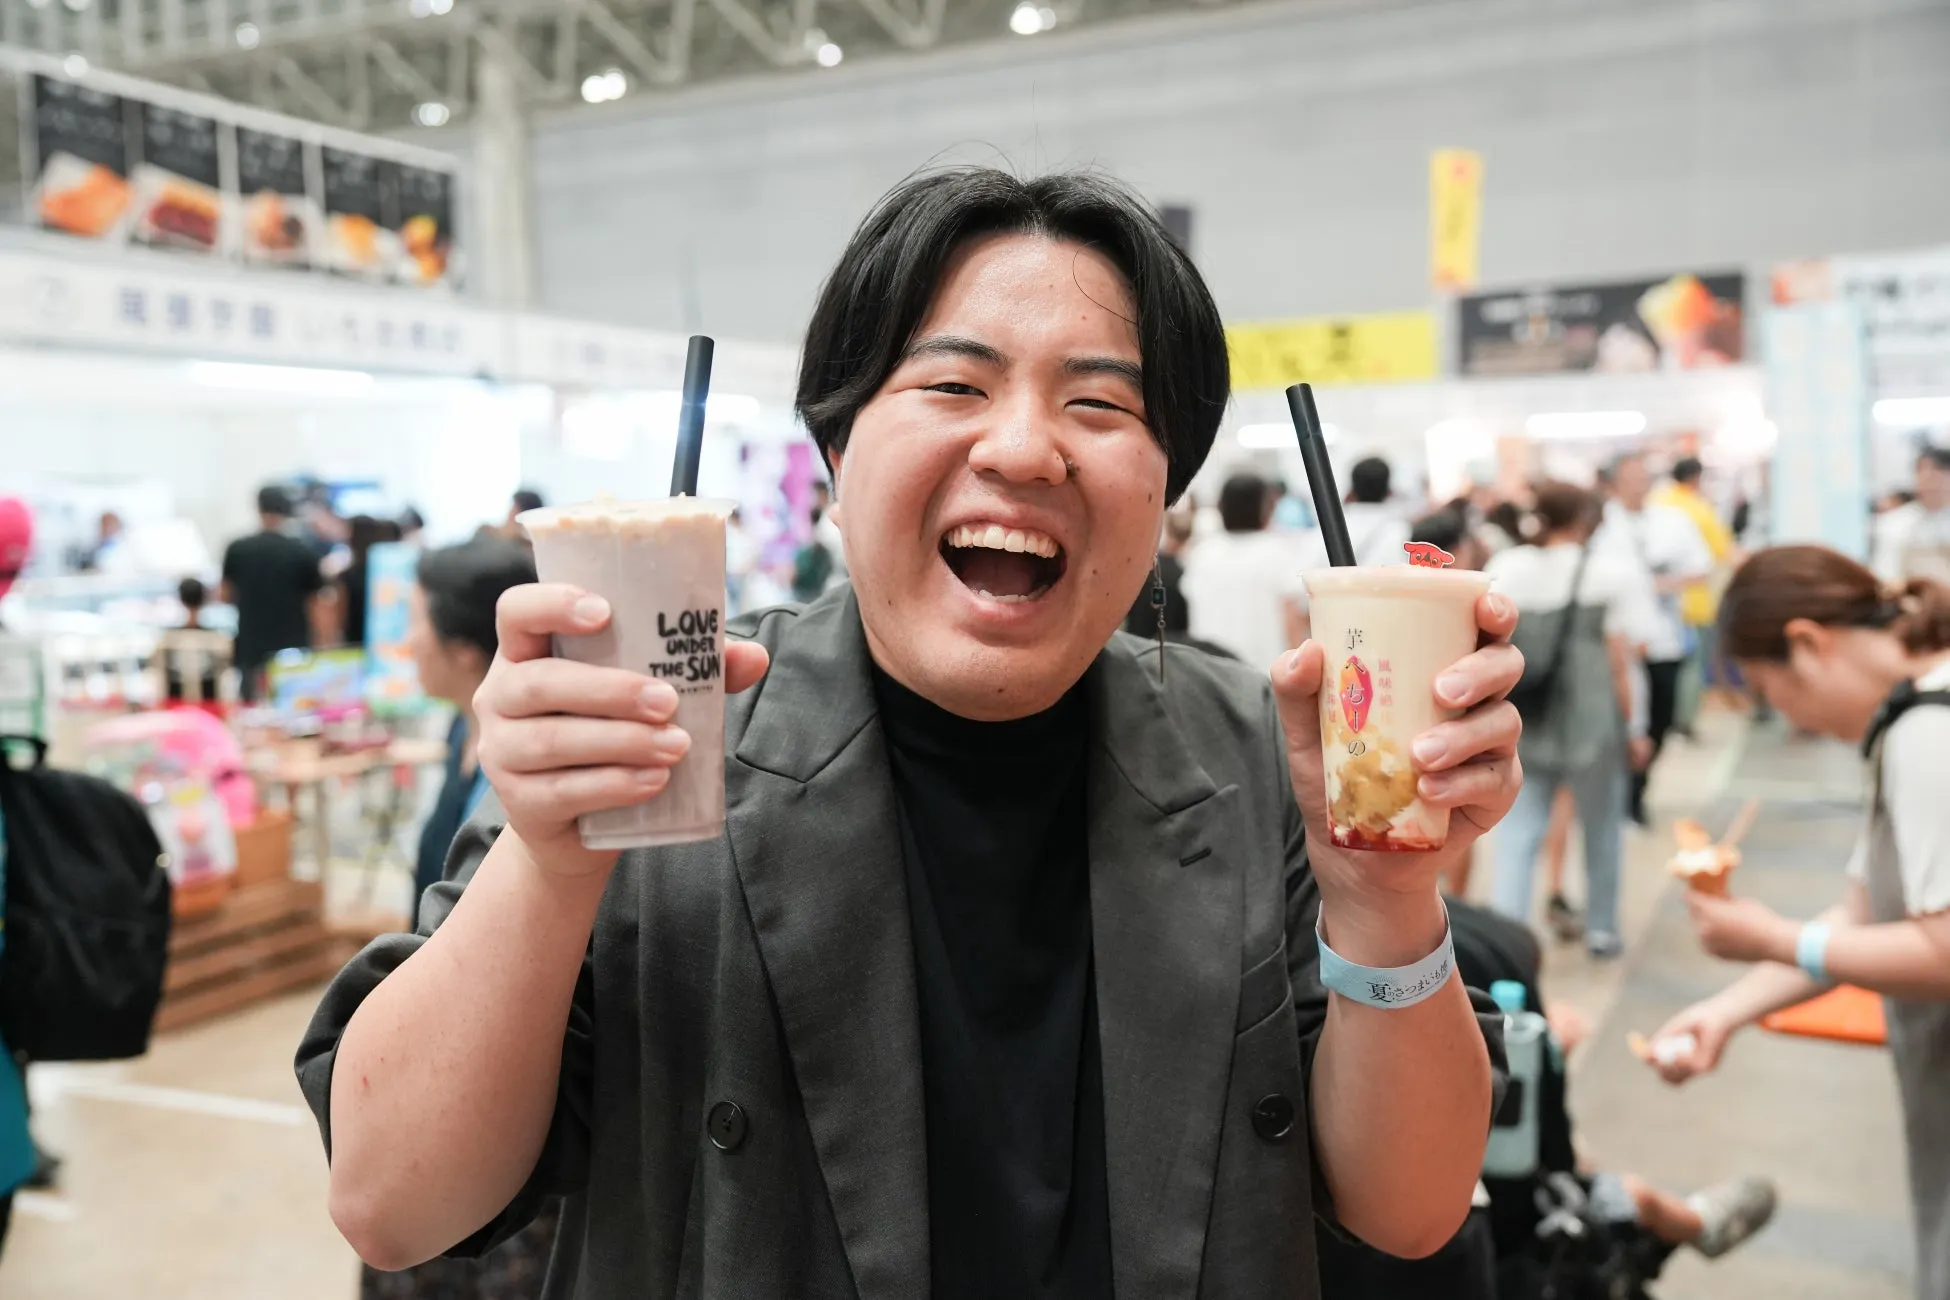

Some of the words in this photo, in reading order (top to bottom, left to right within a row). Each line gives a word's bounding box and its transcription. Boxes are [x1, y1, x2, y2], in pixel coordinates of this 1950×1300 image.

[658, 609, 718, 638] LOVE
[666, 636, 715, 655] UNDER
[649, 661, 684, 677] THE
[686, 653, 720, 682] SUN
